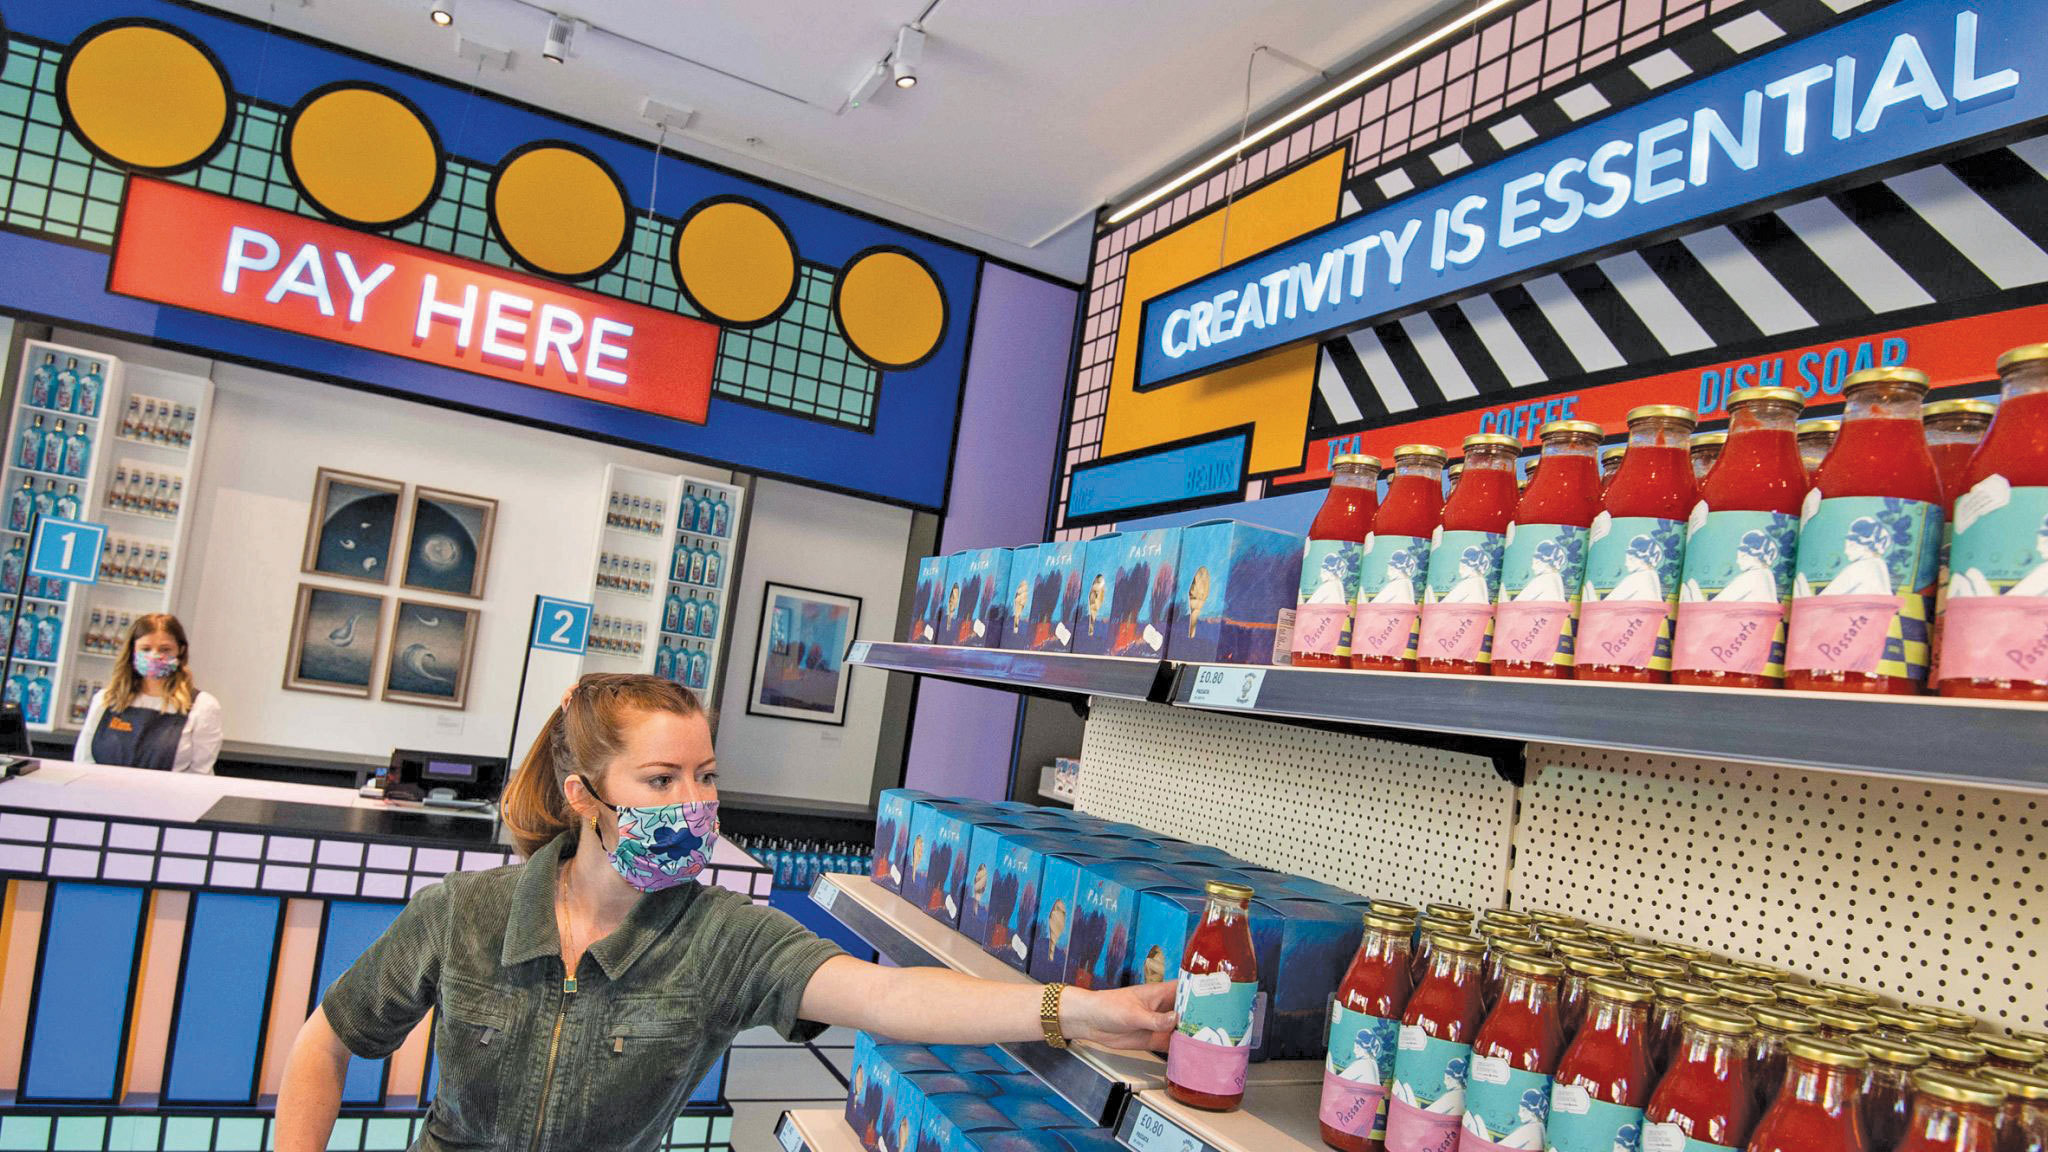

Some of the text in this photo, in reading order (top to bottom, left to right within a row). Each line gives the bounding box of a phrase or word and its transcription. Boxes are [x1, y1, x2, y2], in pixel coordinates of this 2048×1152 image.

[1161, 10, 2019, 359] CREATIVITY IS ESSENTIAL
[221, 226, 635, 386] PAY HERE
[1698, 358, 1784, 414] DISH
[1479, 396, 1578, 441] COFFEE
[1185, 460, 1235, 494] BEANS
[61, 532, 76, 570] 1
[969, 560, 990, 572] PASTA
[1045, 554, 1073, 567] PASTA
[1129, 544, 1163, 559] PASTA
[550, 609, 574, 644] 2
[1303, 616, 1332, 647] Passata
[1368, 617, 1401, 650] Passata
[1438, 617, 1473, 653] Passata
[1511, 617, 1549, 654] Passata
[1602, 617, 1644, 658] Passata
[1710, 619, 1757, 664] Passata
[1818, 612, 1868, 662] Passata
[1199, 670, 1224, 685] £0.80
[884, 804, 903, 816] PASTA
[939, 827, 960, 841] PASTA
[1003, 855, 1029, 873] PASTA
[1087, 889, 1118, 912] PASTA
[873, 1065, 890, 1086] PASTA
[1140, 1113, 1164, 1137] £0.80
[1336, 1094, 1366, 1128] Passata
[929, 1118, 950, 1144] PASTA
